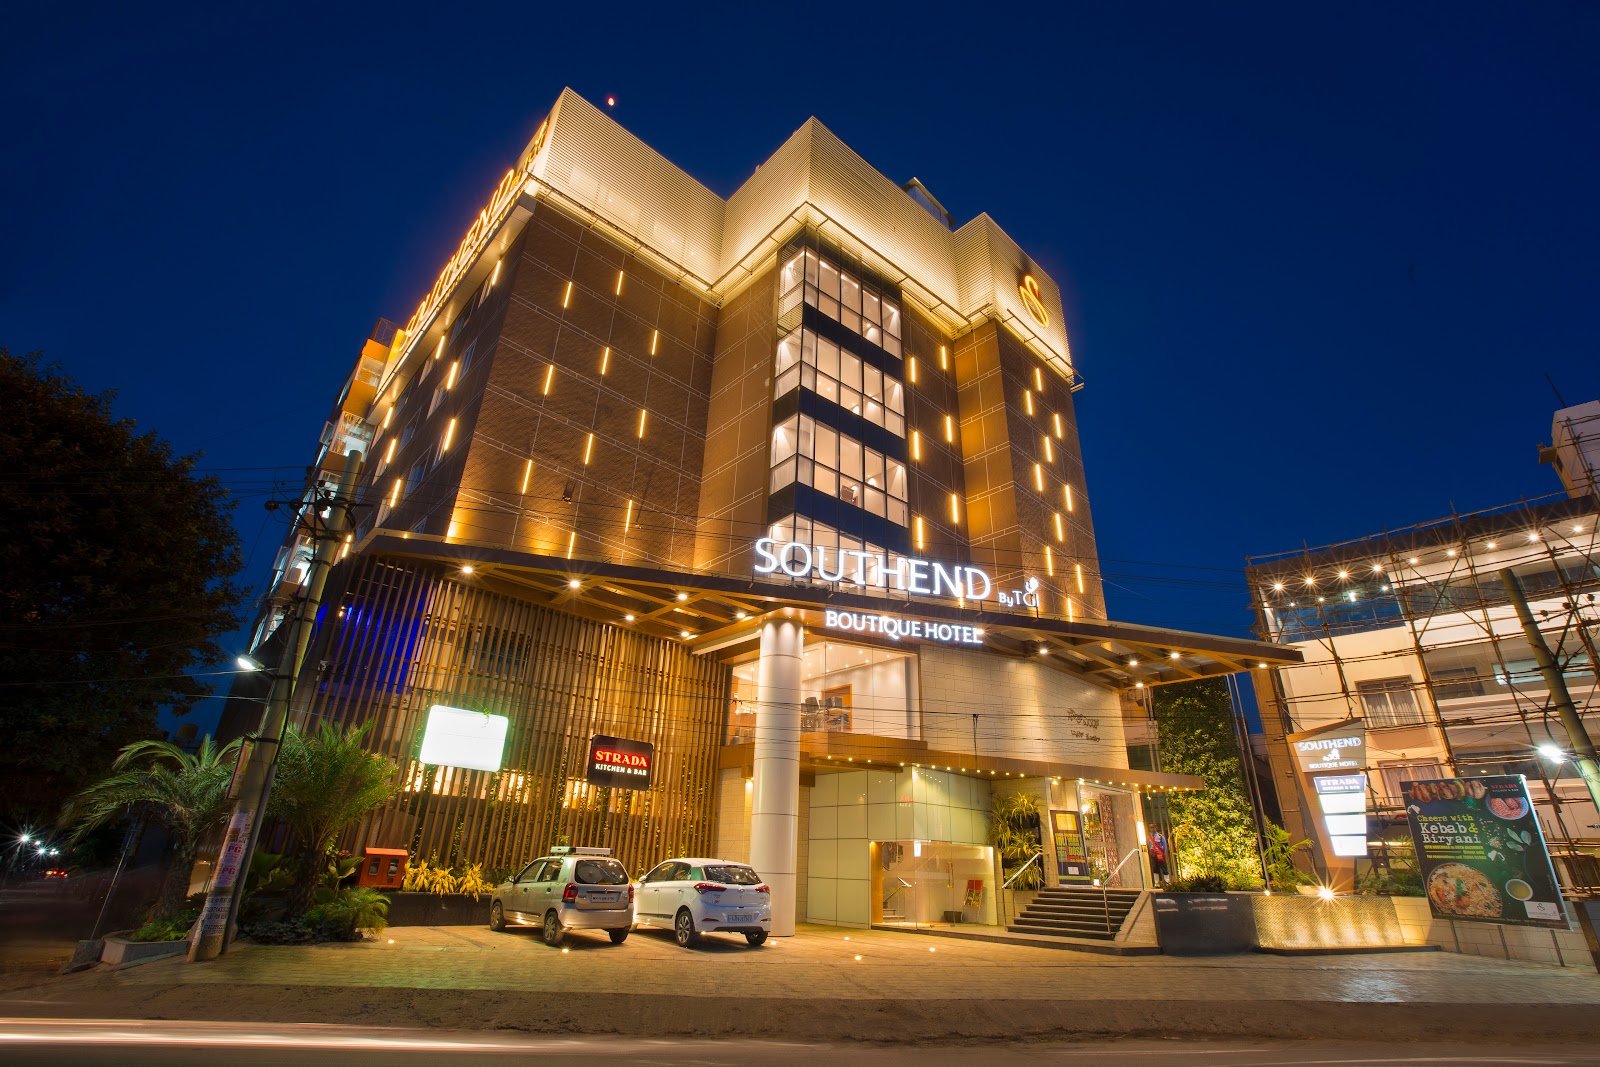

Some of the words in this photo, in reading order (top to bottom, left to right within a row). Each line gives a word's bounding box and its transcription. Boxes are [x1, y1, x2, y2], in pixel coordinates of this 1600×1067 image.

[754, 537, 991, 600] SOUTHEND
[998, 592, 1013, 607] By
[825, 610, 921, 640] BOUTIQUE
[924, 622, 983, 644] HOTEL
[1299, 737, 1361, 751] SOUTHEND
[595, 750, 648, 767] STRADA
[595, 763, 626, 773] KITCHEN
[633, 768, 647, 776] BAR
[1320, 778, 1359, 786] STRADA
[1419, 822, 1468, 834] Kebab
[1468, 822, 1479, 833] &
[1421, 834, 1481, 845] Biryani
[228, 845, 242, 853] PG
